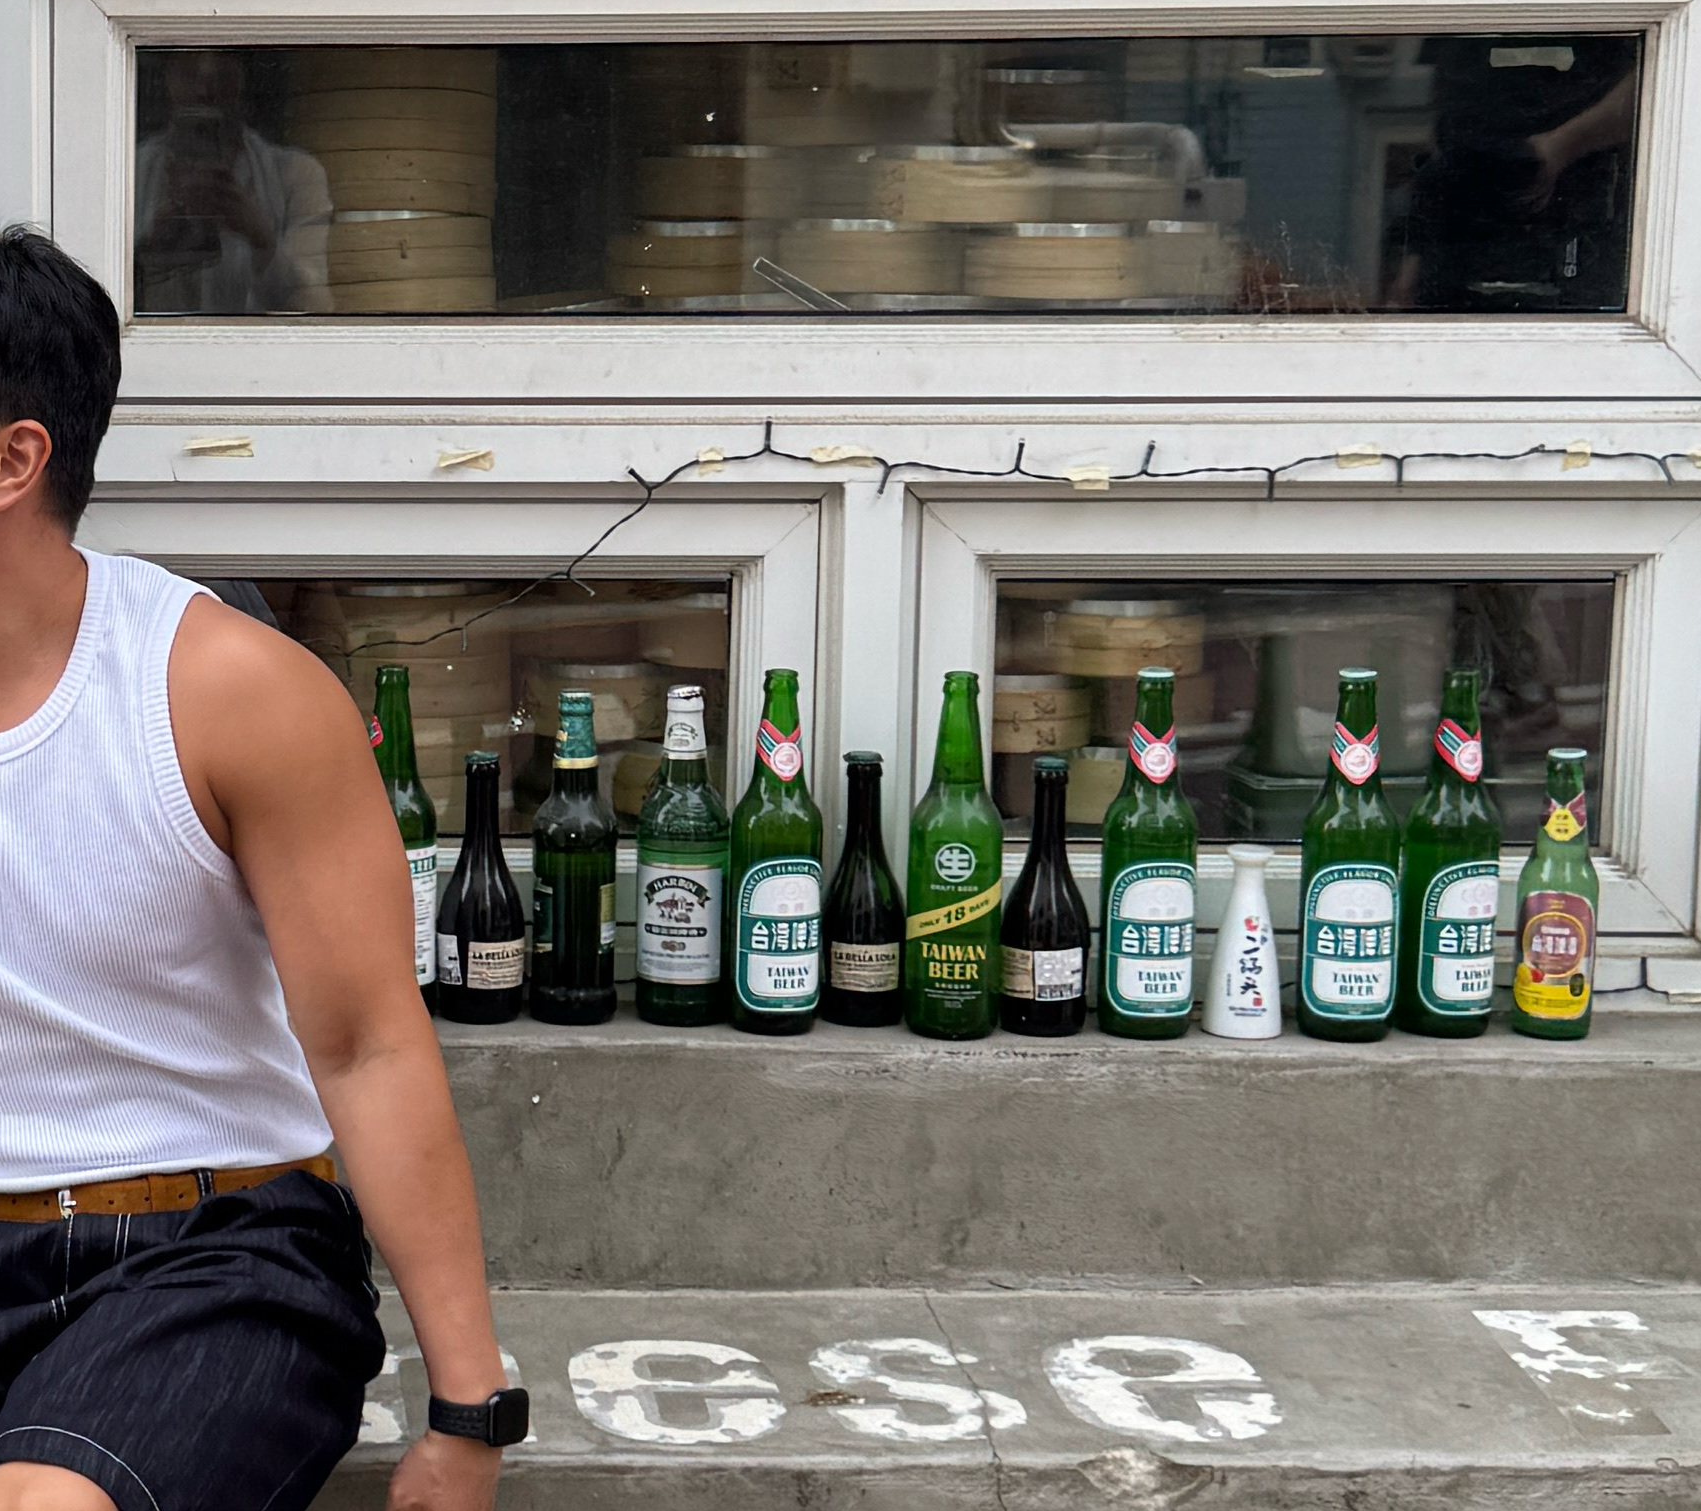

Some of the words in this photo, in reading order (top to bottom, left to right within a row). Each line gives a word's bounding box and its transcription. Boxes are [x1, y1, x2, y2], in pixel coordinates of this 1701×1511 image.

[937, 848, 973, 877] 生
[653, 877, 698, 892] HARBIN
[943, 905, 966, 924] 18
[833, 951, 843, 961] LA
[920, 941, 988, 961] TAIWAN
[767, 966, 810, 978] TAIWAN
[928, 962, 979, 980] BEER
[1138, 971, 1183, 982] TAIWAN
[773, 979, 806, 989] BEER
[1332, 972, 1380, 984] TAIWAN
[1144, 983, 1178, 993] BEER
[1339, 985, 1374, 996] BEER
